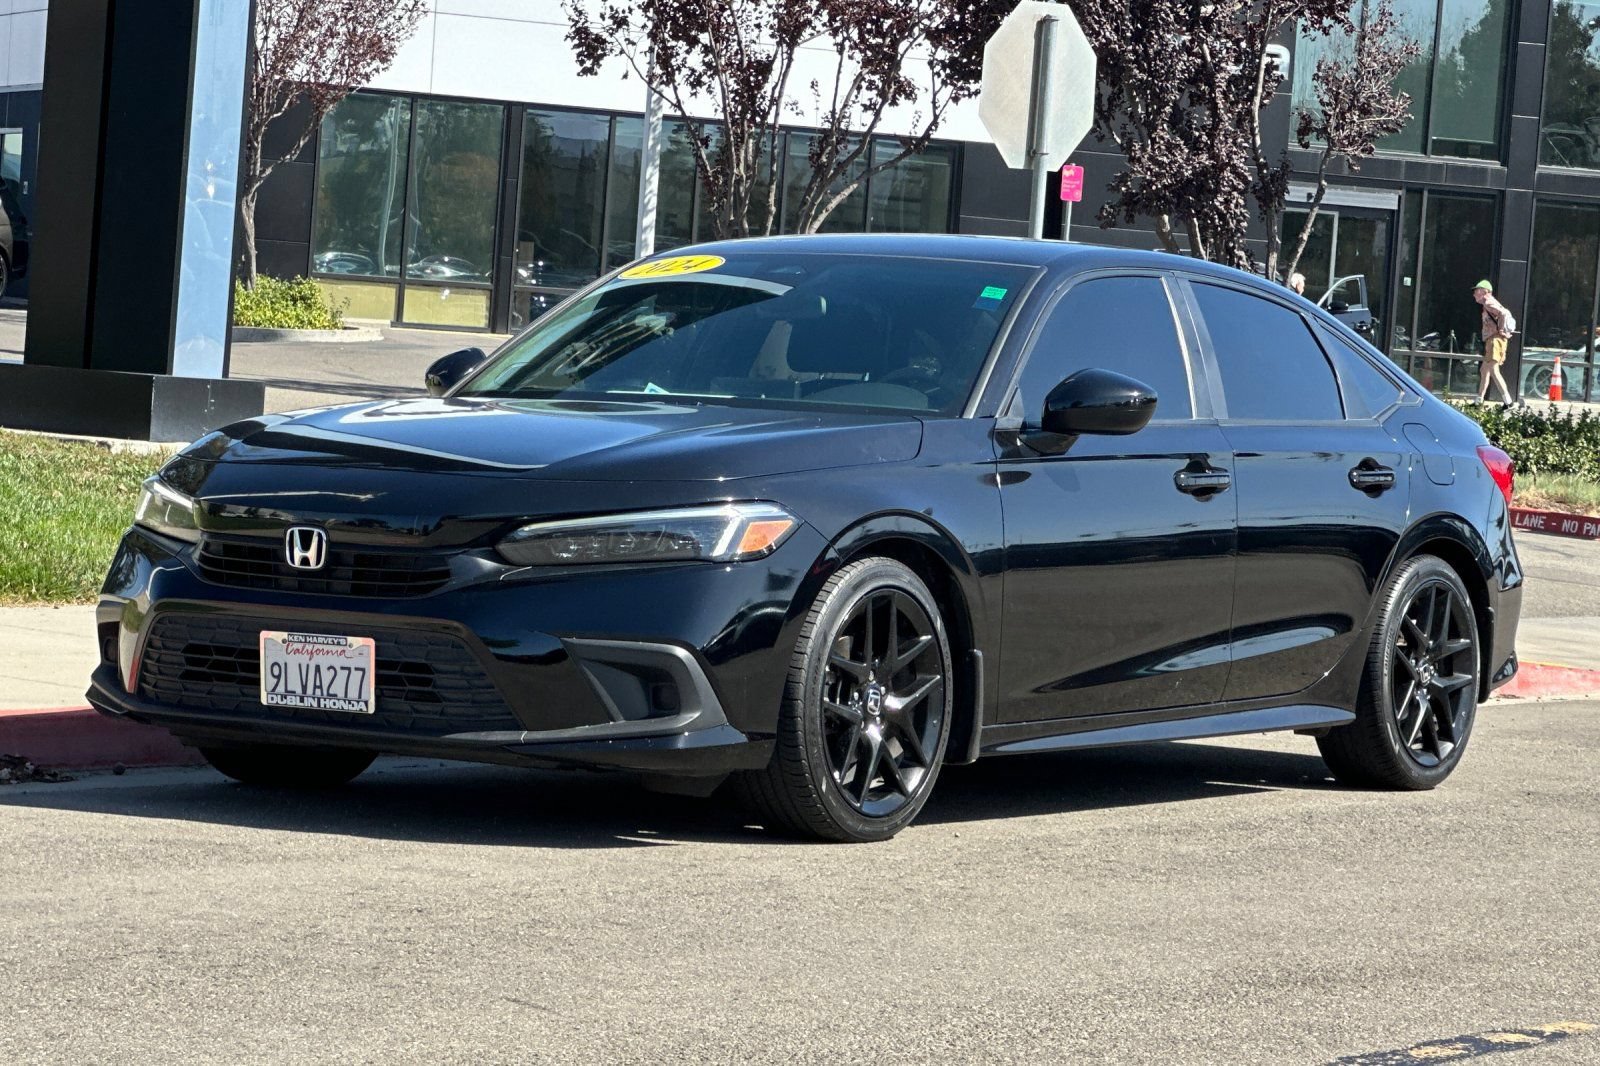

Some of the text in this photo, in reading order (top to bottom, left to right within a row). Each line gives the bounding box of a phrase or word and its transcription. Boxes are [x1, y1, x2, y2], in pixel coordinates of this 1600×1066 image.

[1515, 512, 1546, 529] LANE
[1561, 519, 1579, 533] NO
[288, 634, 347, 645] KEN HARVEY'S
[285, 642, 354, 661] California
[270, 661, 366, 700] 9LVA277
[267, 694, 368, 711] DUBLIN HONDA
